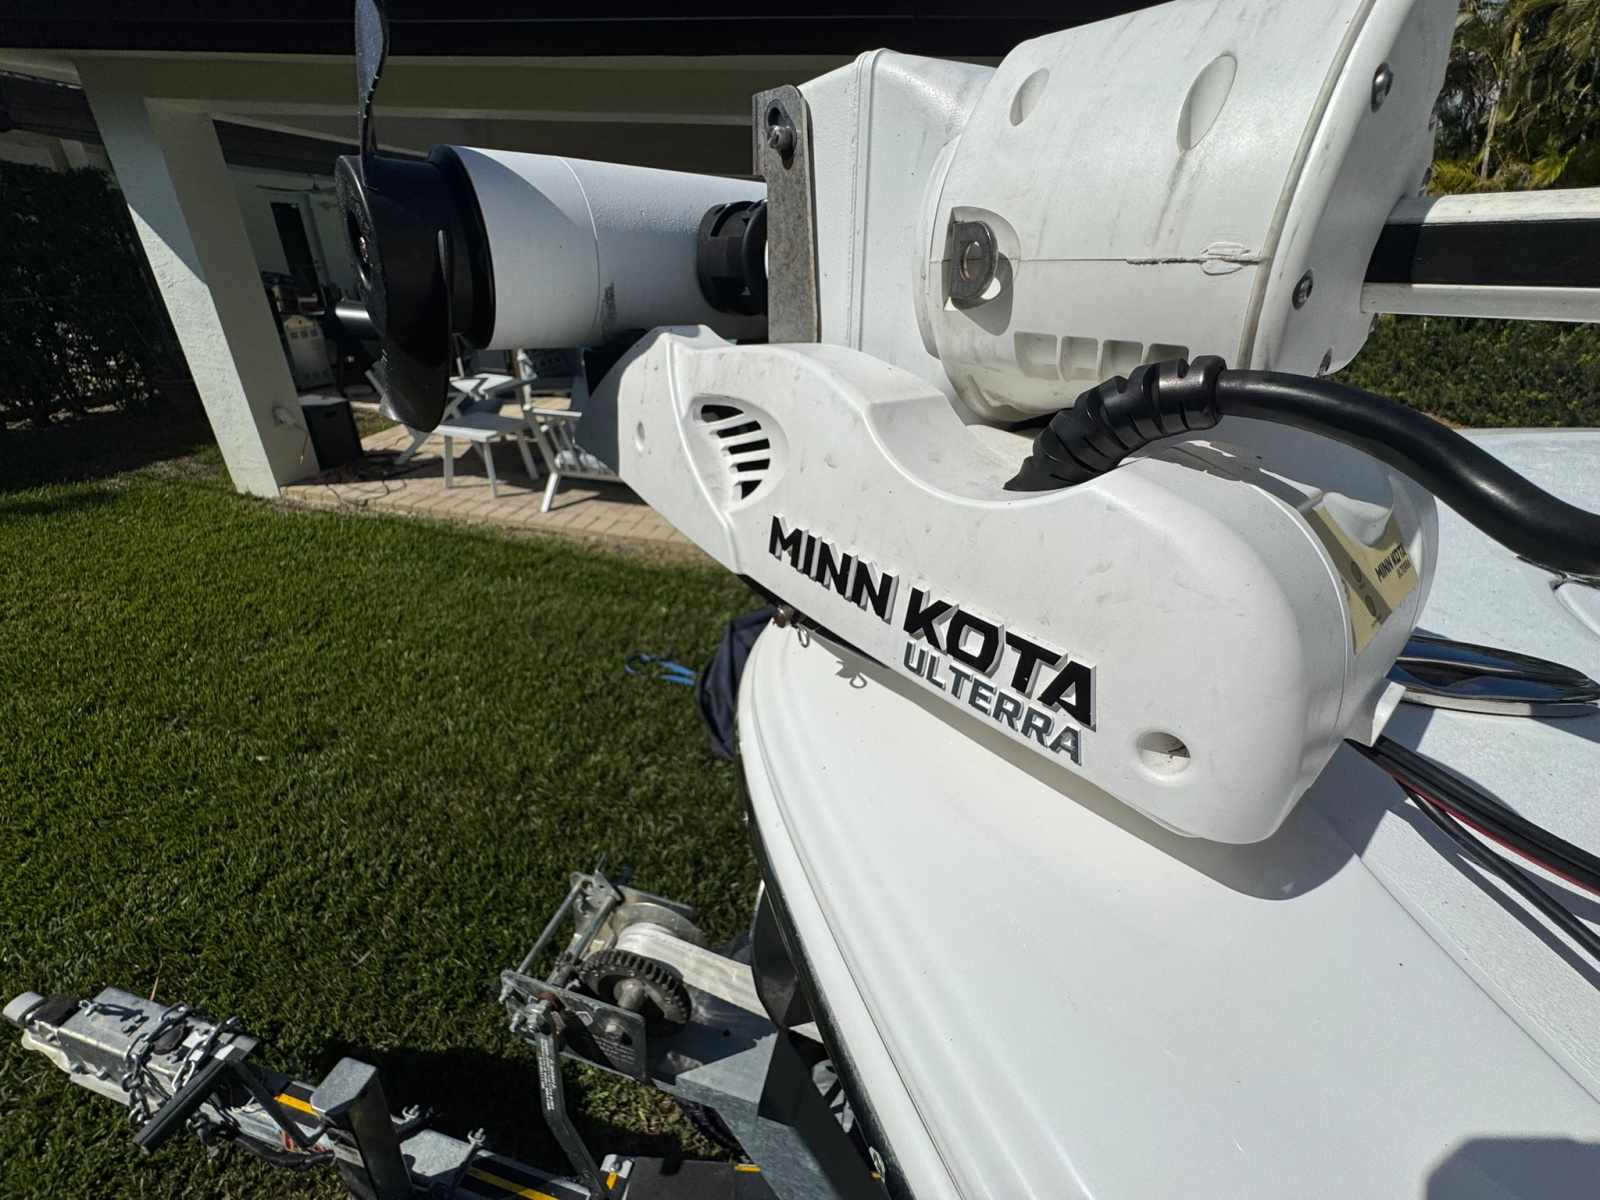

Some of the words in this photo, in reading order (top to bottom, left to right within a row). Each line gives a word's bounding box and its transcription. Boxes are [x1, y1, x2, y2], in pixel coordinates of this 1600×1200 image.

[769, 515, 898, 625] MINN
[903, 587, 1097, 731] KOTA
[1374, 555, 1394, 583] MINN
[904, 641, 1082, 766] ULTERRA
